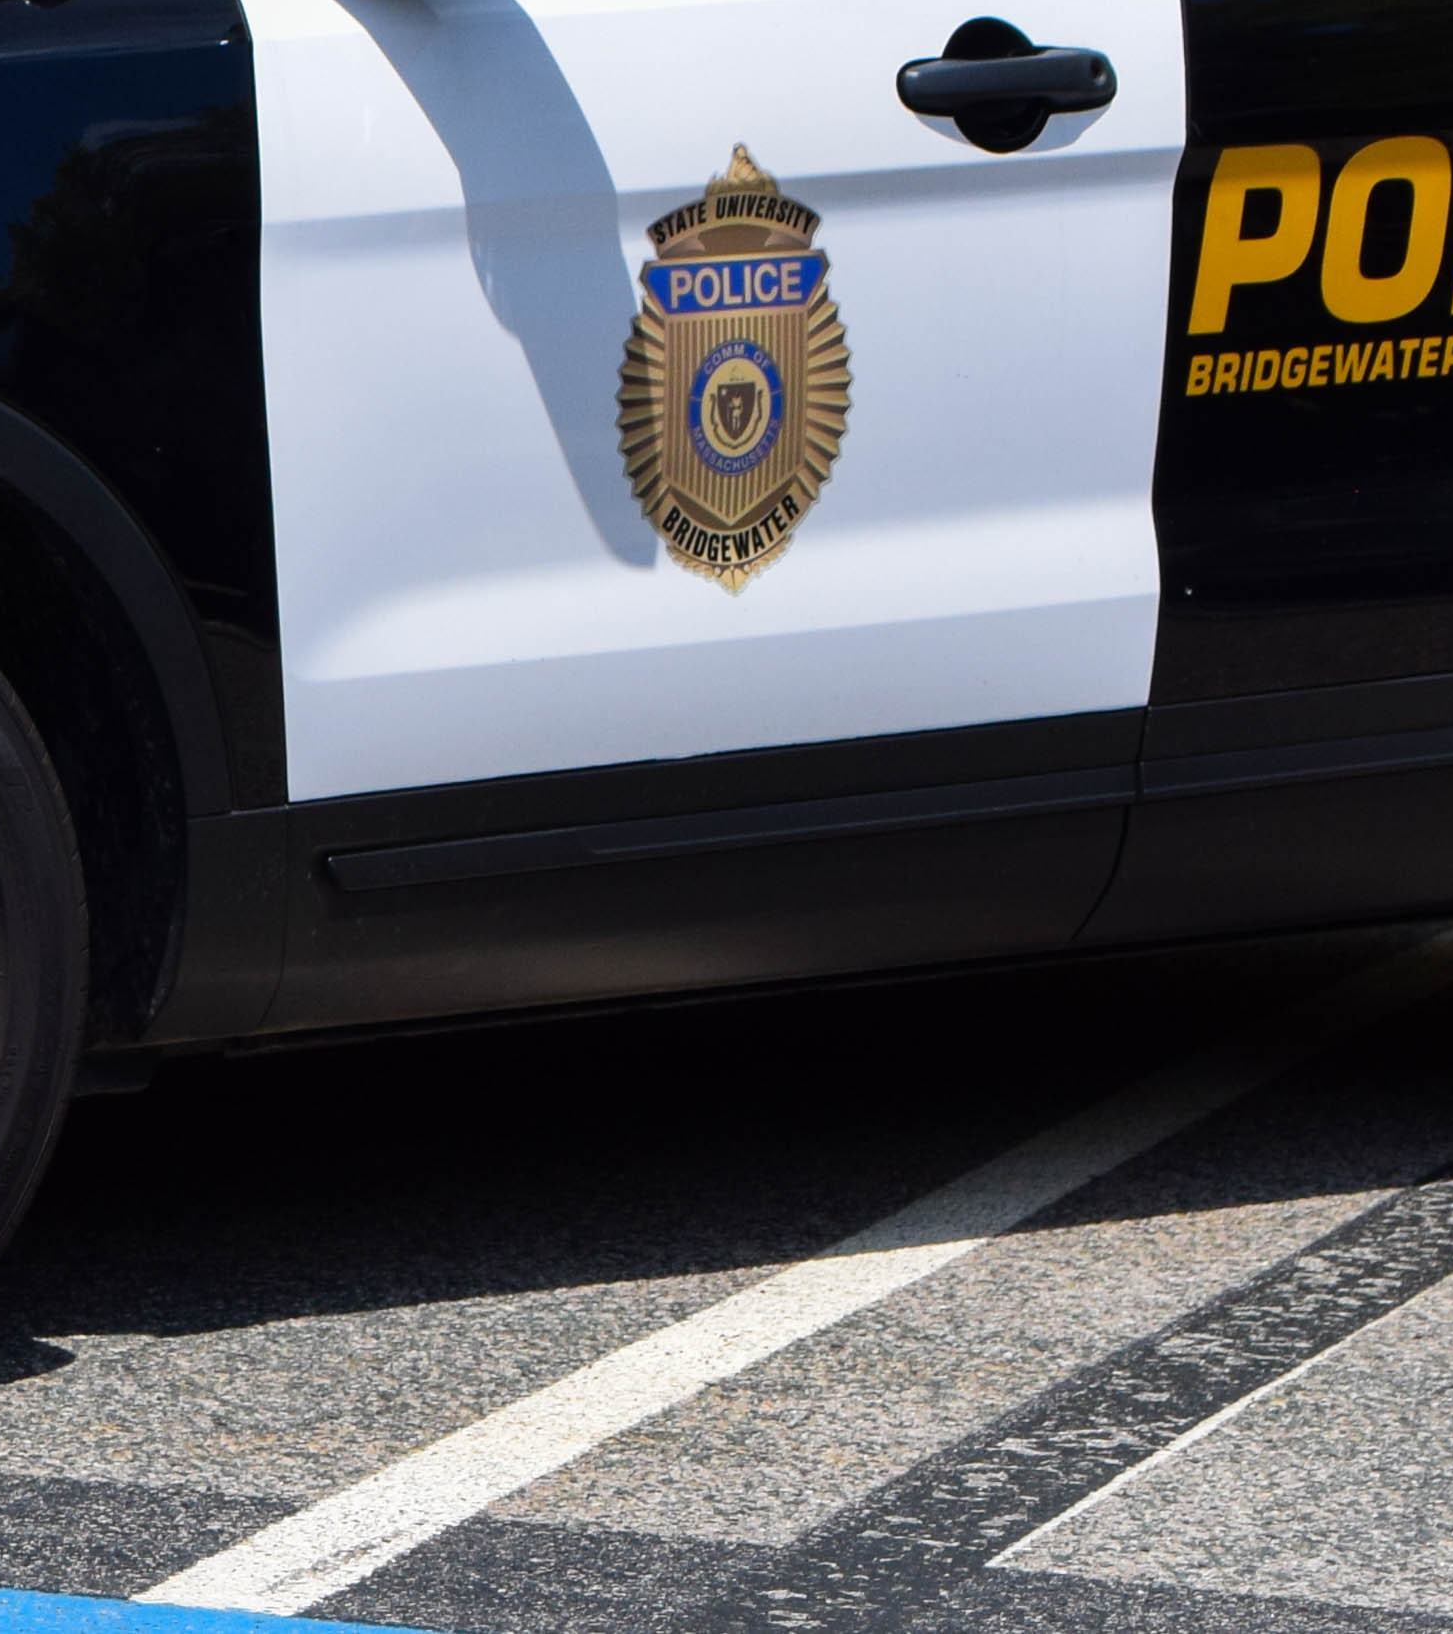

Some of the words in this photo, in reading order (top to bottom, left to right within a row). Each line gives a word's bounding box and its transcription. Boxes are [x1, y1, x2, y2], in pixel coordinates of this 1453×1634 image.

[653, 199, 708, 245] STATE
[715, 194, 818, 235] UNIVERSITY
[669, 261, 805, 309] POLICE
[752, 350, 772, 371] OF
[693, 418, 780, 472] MASSACHUSETTS
[661, 494, 802, 564] BRIDGEWATER
